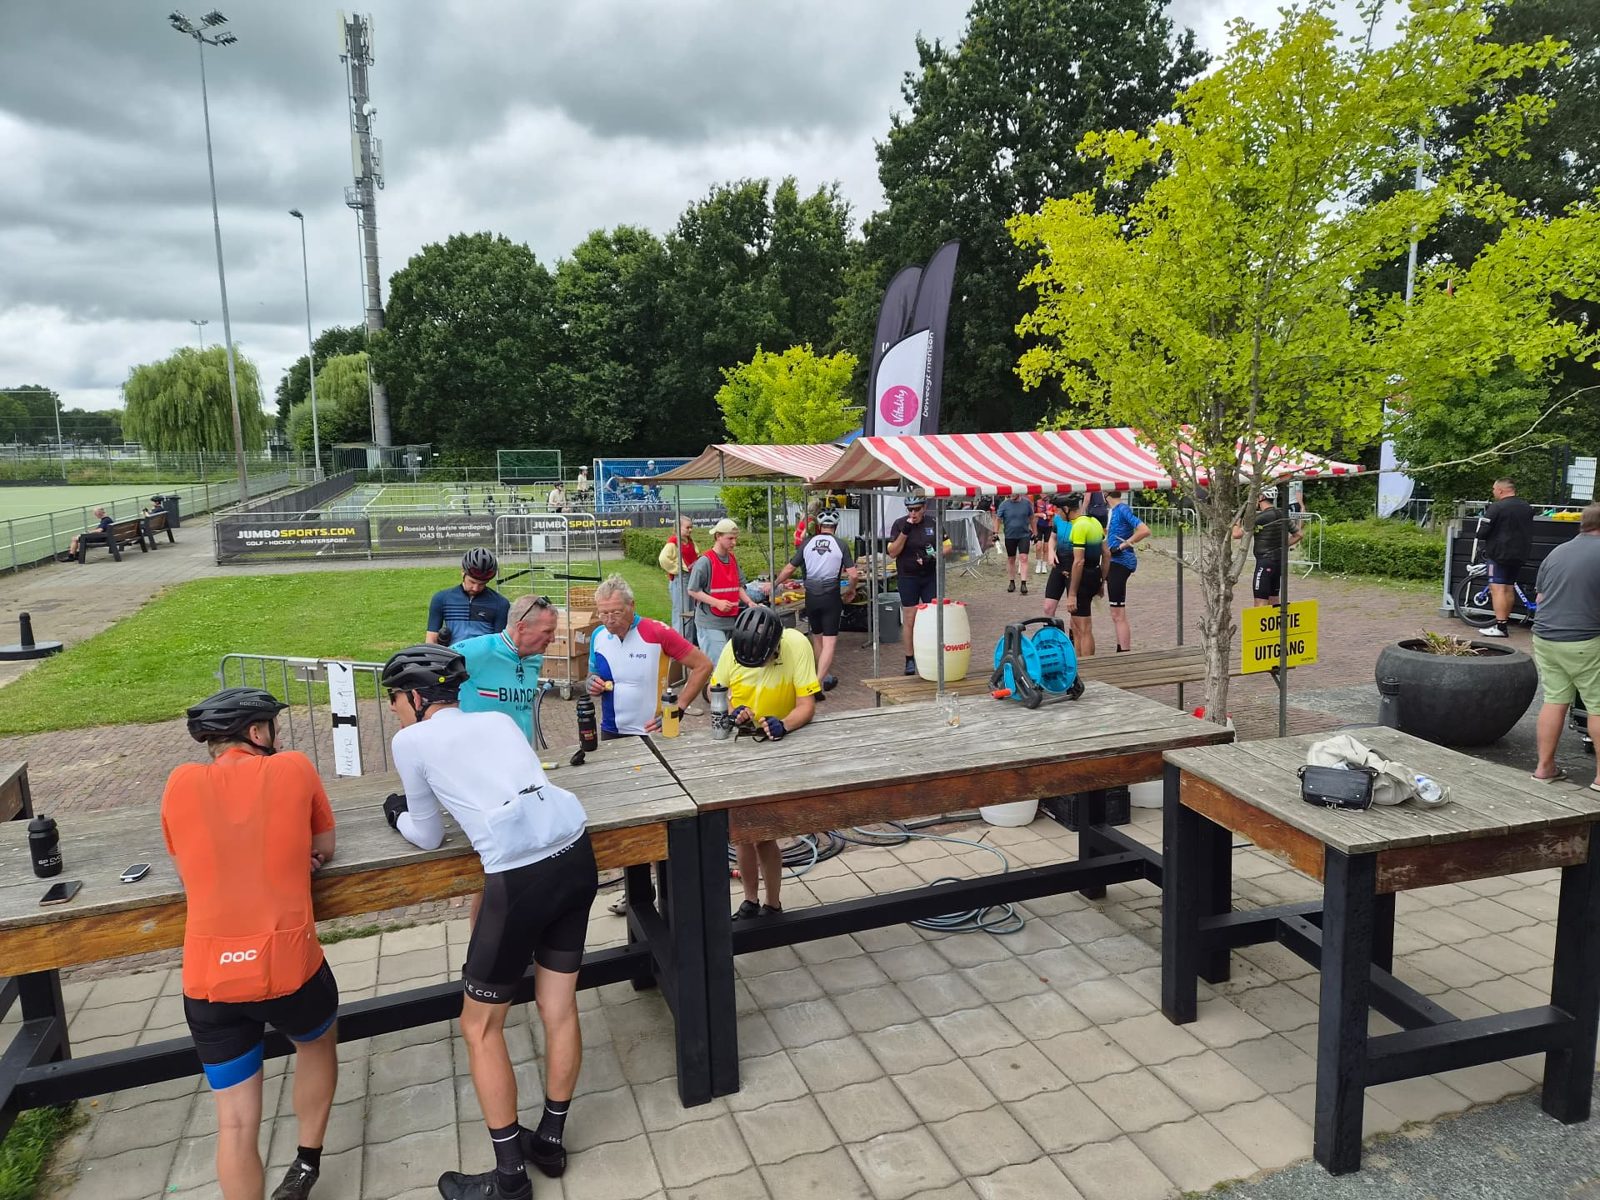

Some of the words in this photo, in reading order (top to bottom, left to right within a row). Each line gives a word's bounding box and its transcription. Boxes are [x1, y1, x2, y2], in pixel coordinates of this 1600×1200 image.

[891, 389, 908, 423] Vitality
[237, 528, 355, 539] JUMBOSPORTS.COM
[465, 980, 474, 993] LE
[475, 989, 499, 998] COL
